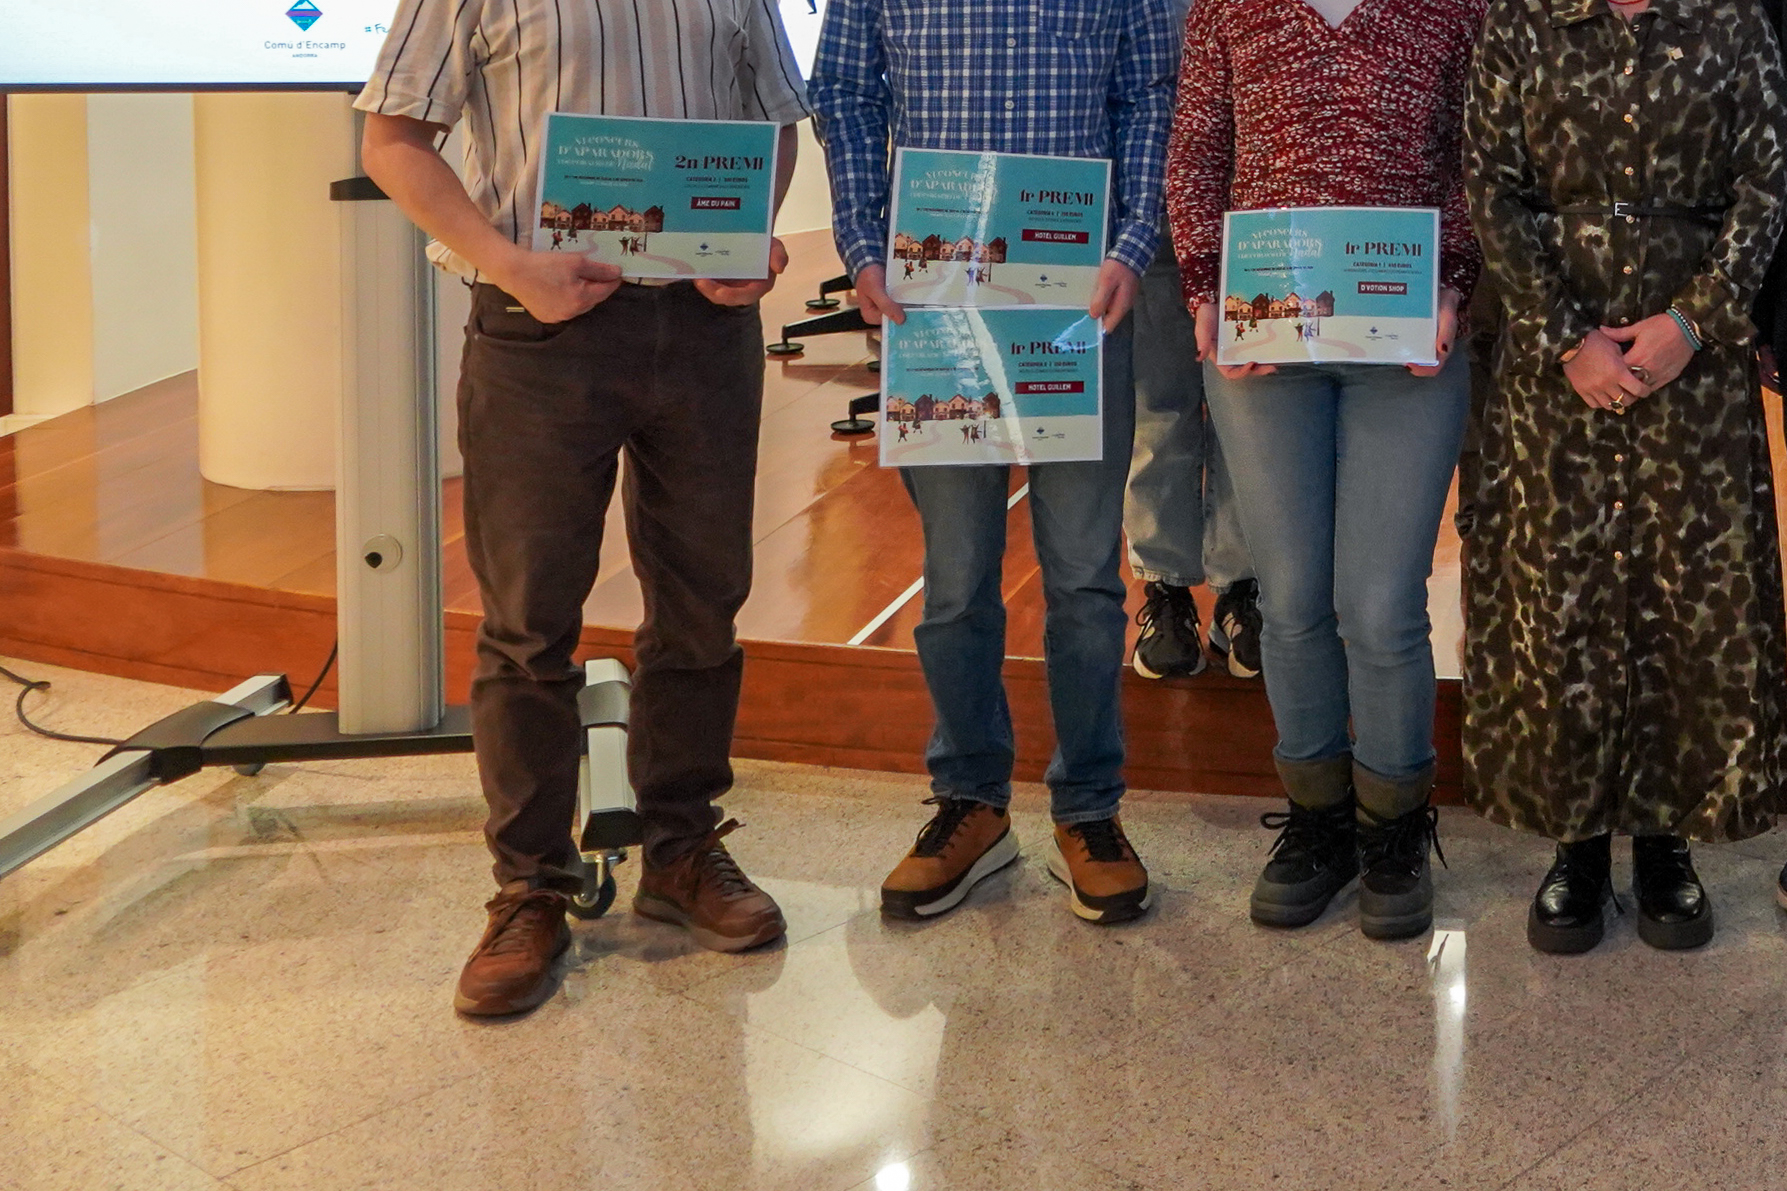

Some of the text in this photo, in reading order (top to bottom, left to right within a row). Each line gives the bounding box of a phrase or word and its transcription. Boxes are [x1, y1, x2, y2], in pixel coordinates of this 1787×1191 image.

[264, 41, 293, 49] Comú
[675, 155, 763, 170] 2n PREMI
[1039, 190, 1093, 206] PREMI
[1346, 241, 1421, 256] 1r PREMI
[1011, 342, 1025, 355] 1r
